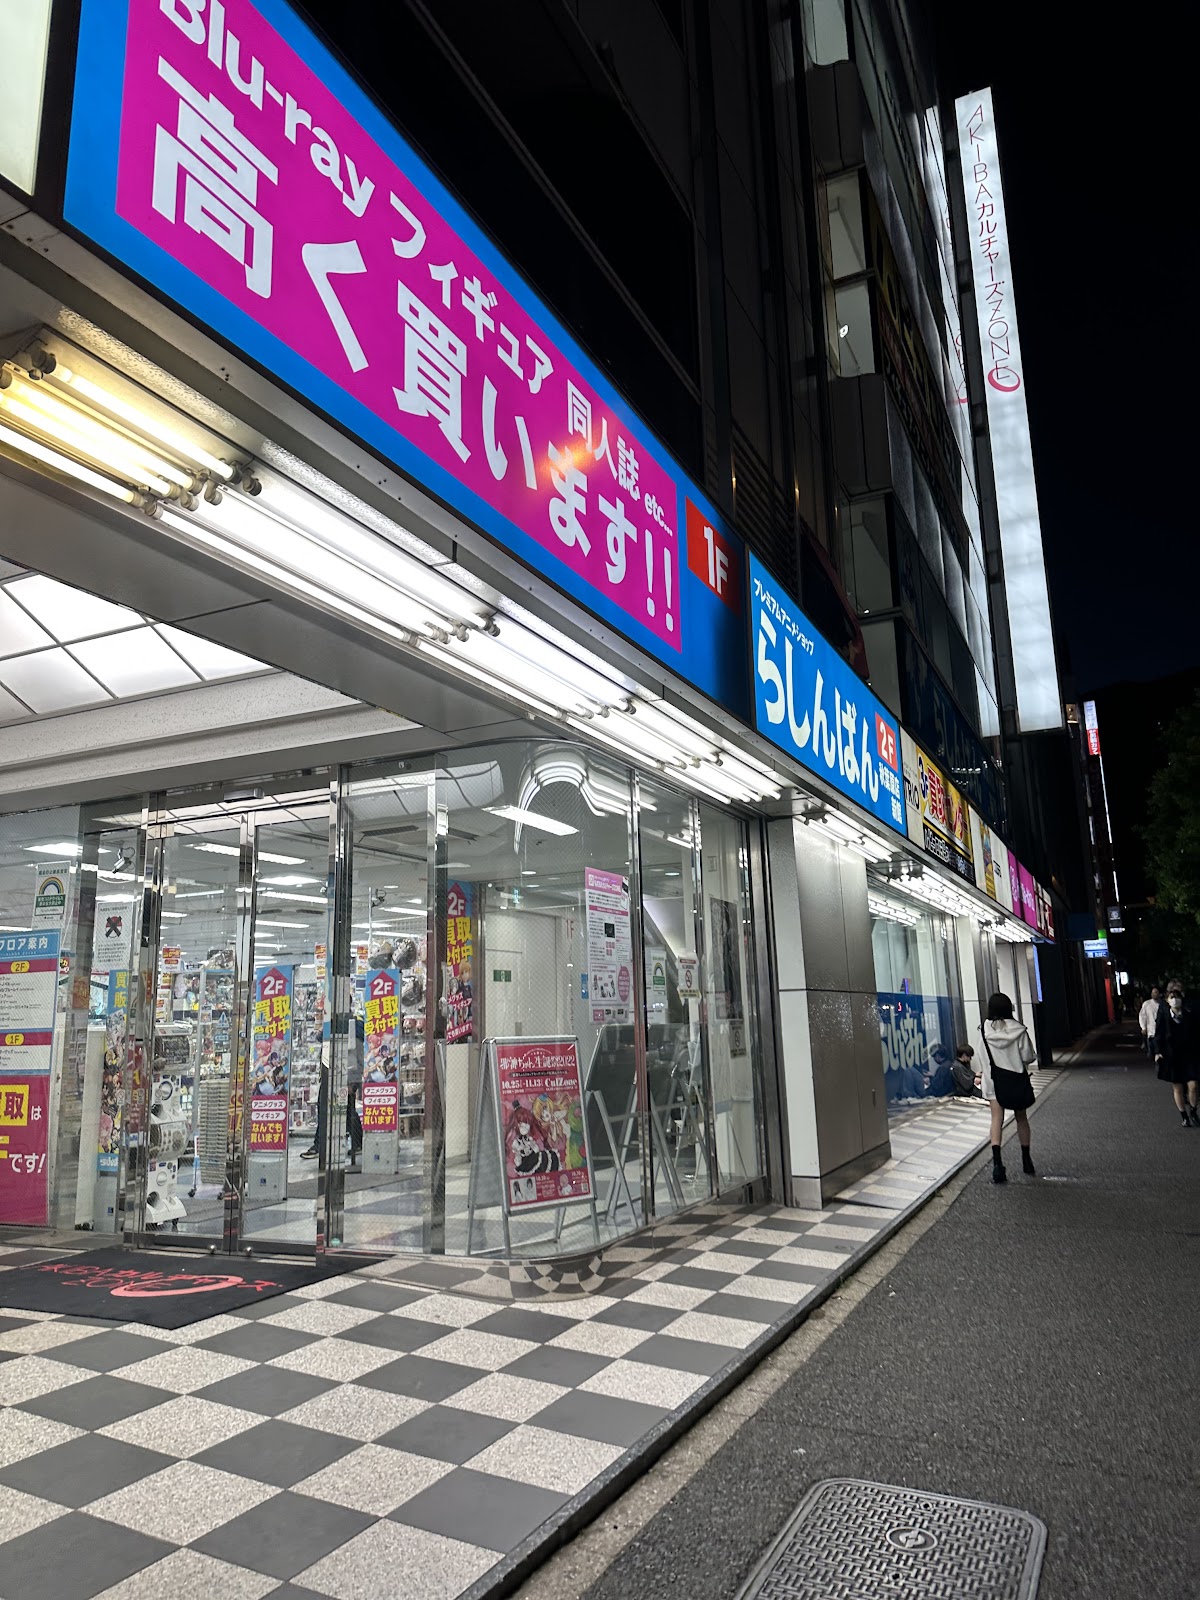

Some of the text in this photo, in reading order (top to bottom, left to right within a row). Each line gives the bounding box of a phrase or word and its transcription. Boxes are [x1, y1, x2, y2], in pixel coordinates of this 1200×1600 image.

[158, 0, 375, 218] Blu-ray
[390, 191, 554, 394] フィギュア
[566, 379, 640, 502] 同人誌
[151, 55, 674, 633] 高く買います!!
[702, 525, 729, 596] 1F
[753, 578, 815, 656] プレミアムアニメショップ
[758, 608, 879, 803] らしんばん
[879, 720, 895, 765] 2F
[917, 753, 929, 801] 3F
[448, 892, 465, 916] 2F
[15, 963, 25, 971] 2F
[264, 976, 284, 995] 2F
[373, 979, 392, 996] 2F
[255, 995, 291, 1022] 買取
[365, 995, 399, 1020] 買取
[364, 1016, 399, 1036] 受付中
[10, 1034, 20, 1043] 1F
[366, 1087, 395, 1095] アニメグッズ
[367, 1096, 392, 1104] フィギュア
[253, 1100, 284, 1109] アニメグッズ
[364, 1106, 394, 1116] なんでも
[255, 1112, 281, 1120] フィギュア
[364, 1115, 395, 1125] 買います!
[251, 1122, 283, 1133] なんでも
[250, 1132, 284, 1144] 買います!
[9, 1152, 46, 1174] です!
